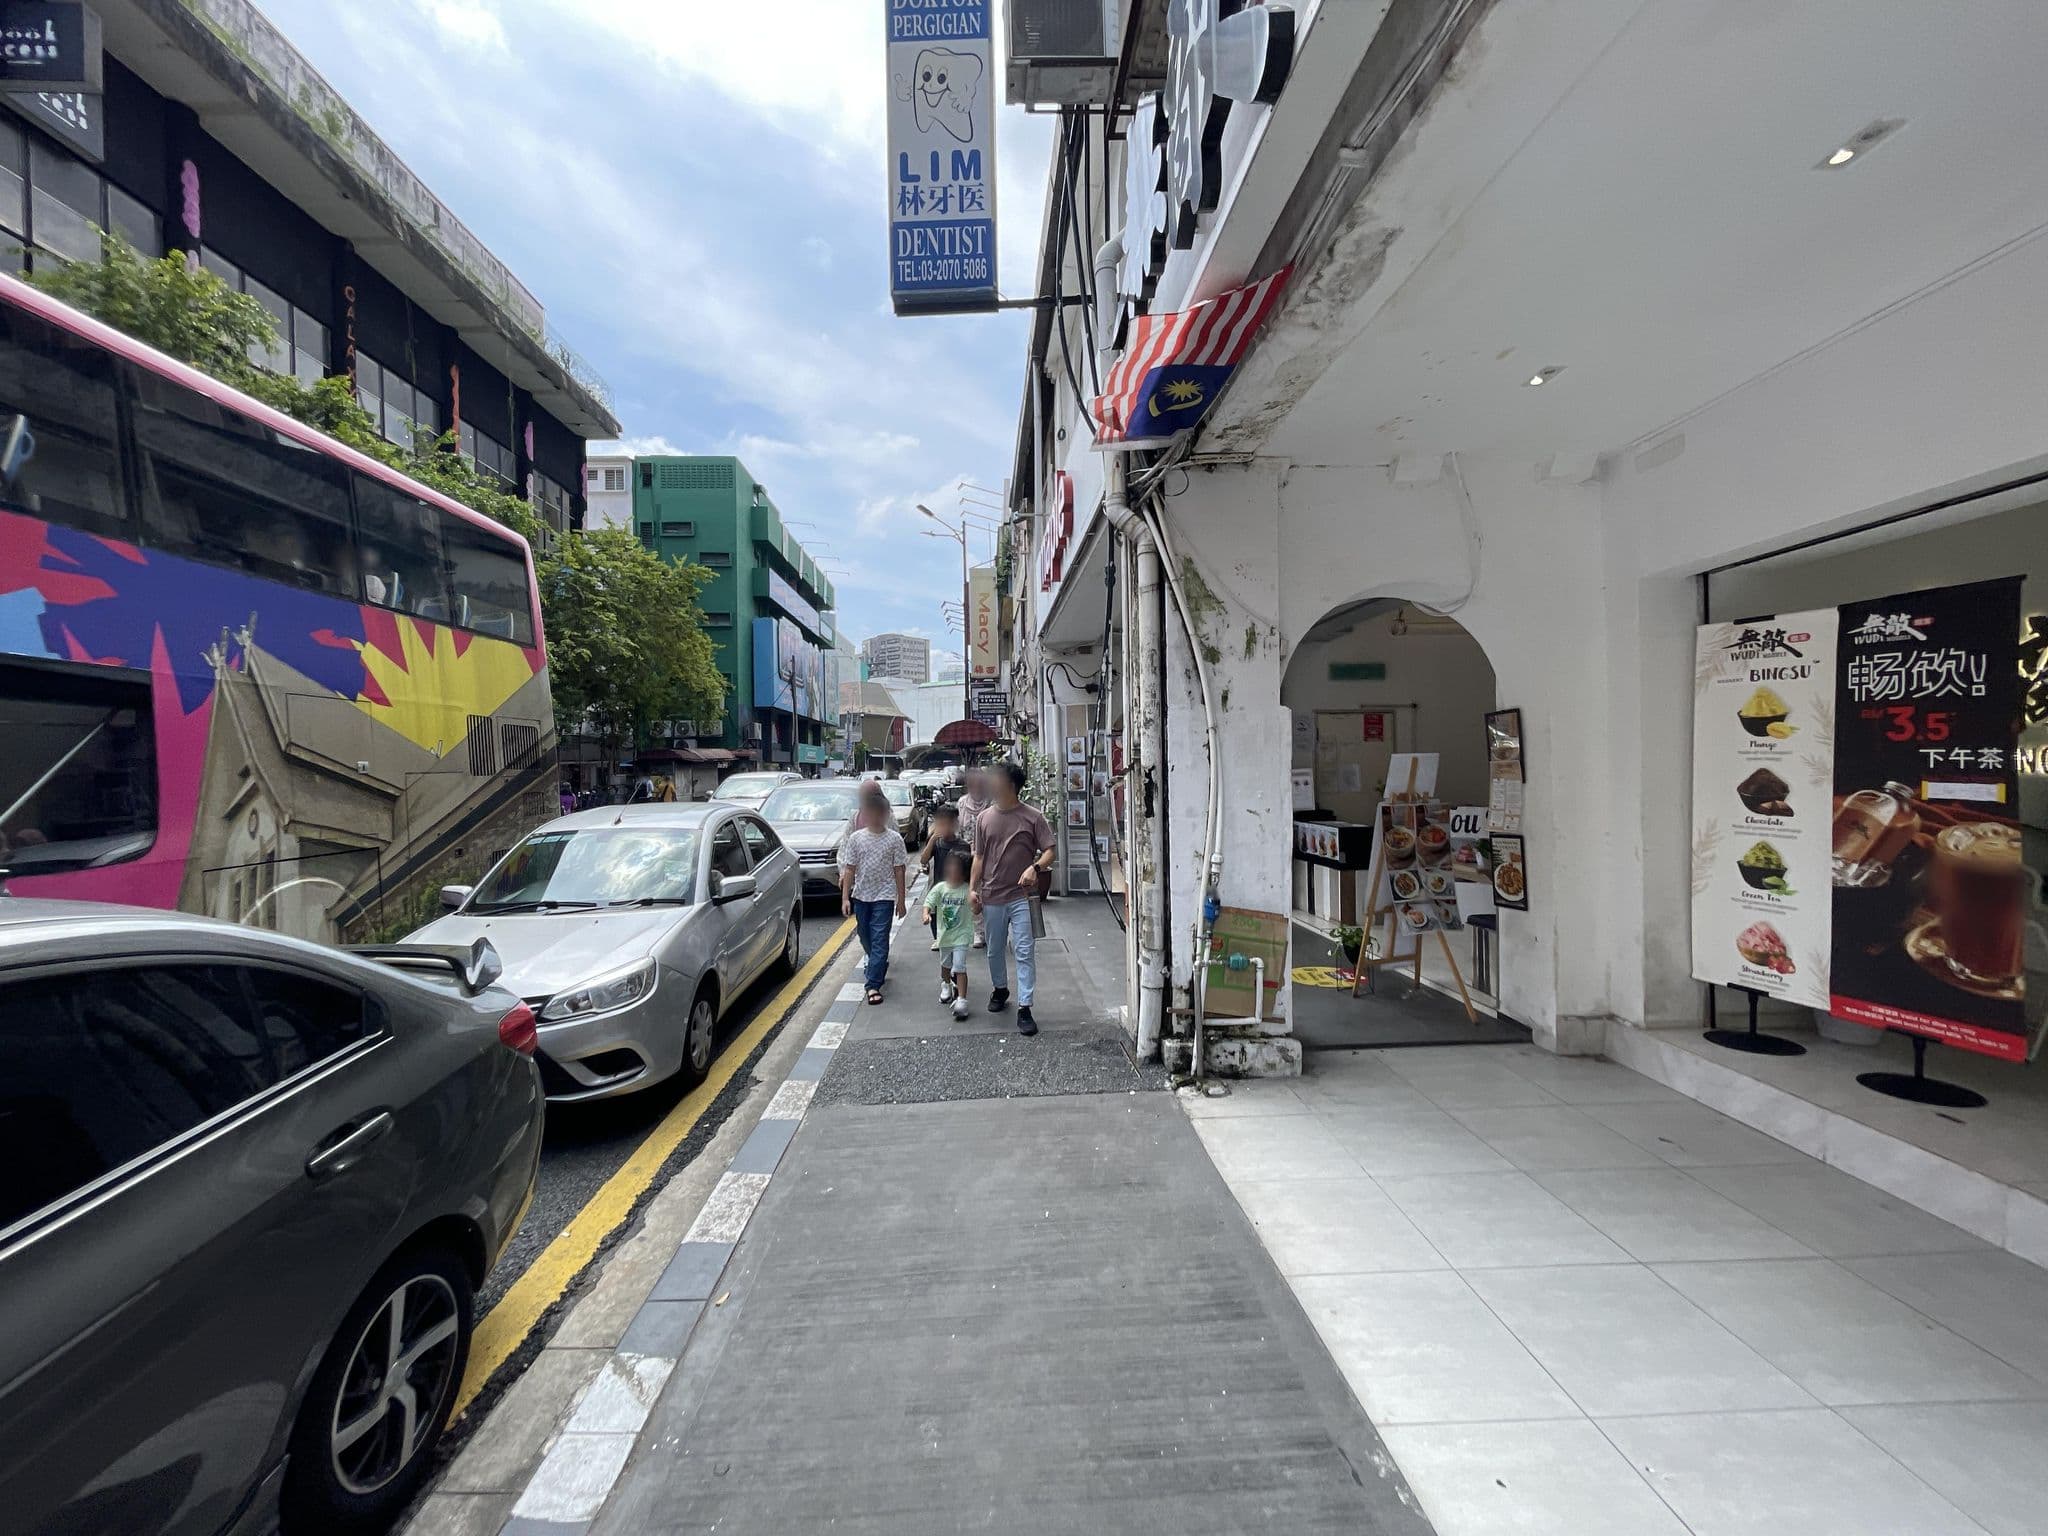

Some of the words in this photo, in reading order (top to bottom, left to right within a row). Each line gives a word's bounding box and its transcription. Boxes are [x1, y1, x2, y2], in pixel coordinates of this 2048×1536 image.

[893, 12, 981, 37] PERGIGIAN
[900, 148, 981, 183] LIM
[897, 184, 985, 216] 林牙医
[898, 224, 986, 258] DENTIST
[898, 260, 961, 282] TEL:03-2070
[963, 257, 987, 280] 5086
[976, 592, 991, 654] Macy
[1750, 664, 1811, 682] BINGSU
[1919, 747, 2004, 770] 下午茶
[1451, 814, 1482, 834] ou
